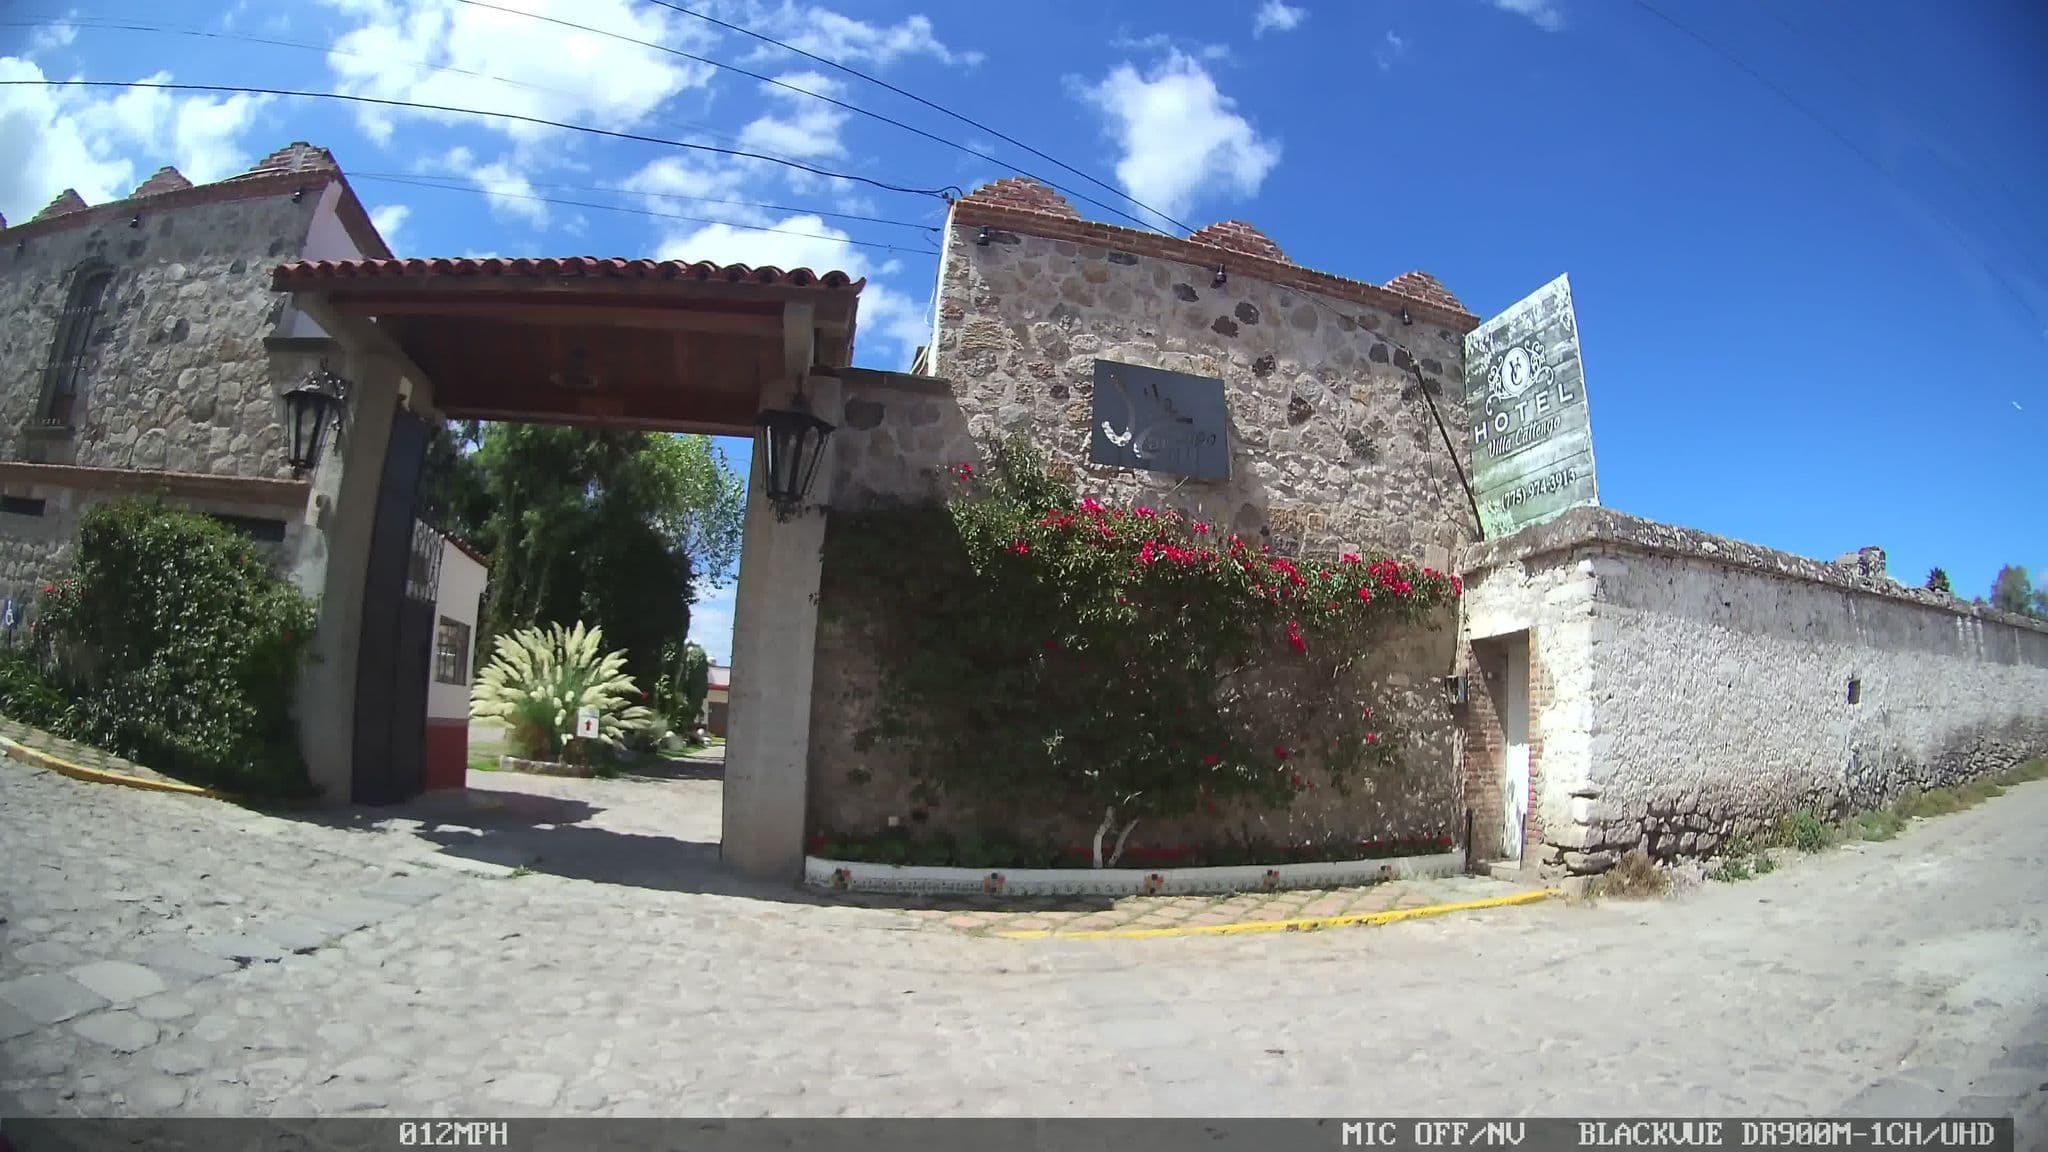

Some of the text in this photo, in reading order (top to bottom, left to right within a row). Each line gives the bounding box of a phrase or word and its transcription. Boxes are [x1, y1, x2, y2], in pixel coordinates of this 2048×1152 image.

[1474, 383, 1574, 444] HOTEL
[1487, 434, 1512, 459] Villa
[1501, 486, 1527, 512] (775)
